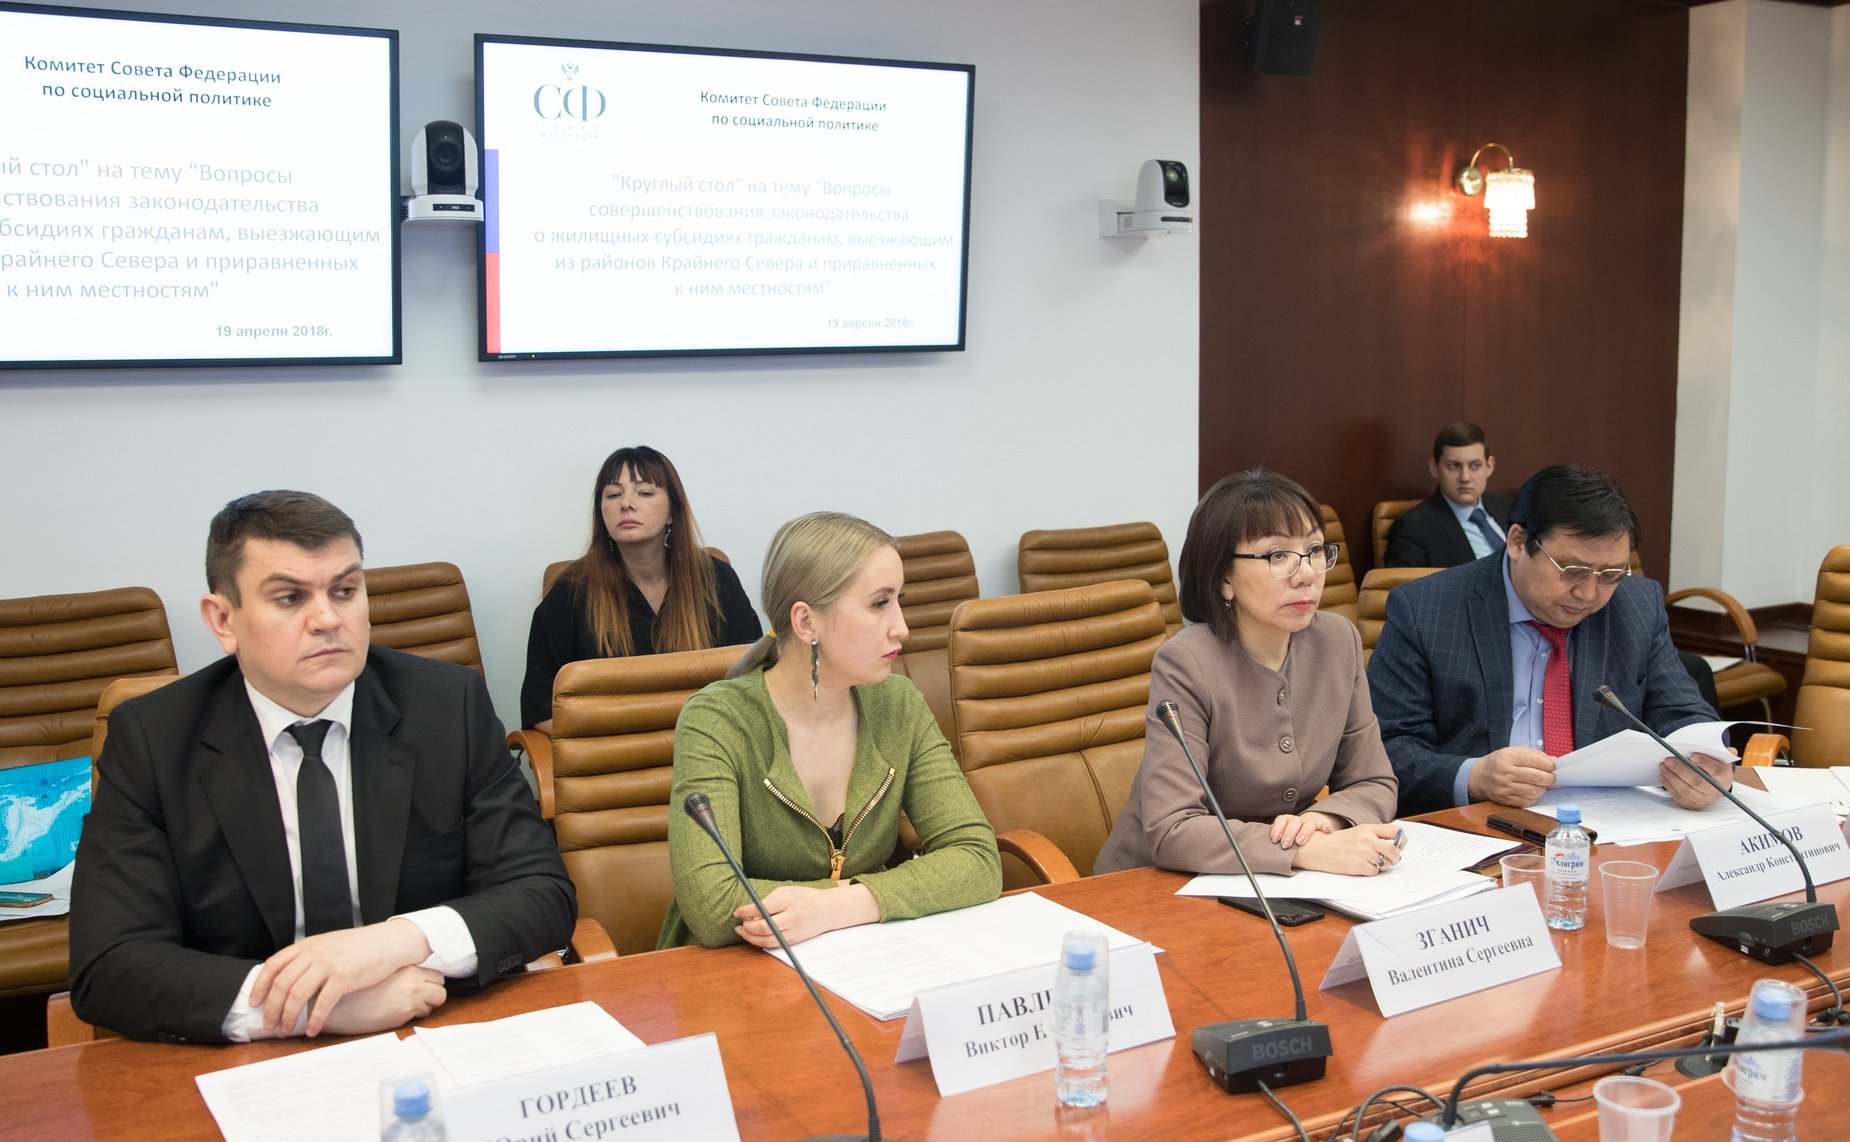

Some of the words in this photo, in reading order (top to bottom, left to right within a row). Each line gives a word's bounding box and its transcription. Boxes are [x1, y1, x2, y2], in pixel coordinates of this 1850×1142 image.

[24, 55, 106, 74] Комитет
[110, 60, 173, 78] Совета
[178, 64, 281, 86] Федерации
[41, 84, 66, 97] по
[70, 86, 183, 103] социальной
[189, 92, 272, 108] политике
[533, 84, 606, 122] СФ
[700, 90, 760, 106] Комитет
[762, 93, 808, 109] Совета
[811, 95, 887, 113] Федерации
[711, 114, 729, 127] по
[731, 115, 817, 129] социальной
[818, 119, 880, 132] политике
[30, 160, 88, 176] стол"
[98, 165, 123, 178] на
[130, 166, 182, 184] тему
[190, 164, 291, 186] "Вопросы
[612, 173, 693, 195] "Круглый
[698, 177, 742, 193] стол"
[748, 183, 768, 192] на
[773, 183, 809, 198] тему
[816, 181, 891, 199] "Вопросы
[129, 197, 318, 213] законодательства
[589, 204, 763, 221] совершенствования
[770, 208, 909, 223] законодательства
[102, 226, 231, 244] гражданам,
[238, 228, 380, 246] выезжающим
[534, 230, 545, 243] о
[550, 231, 649, 246] жилищных
[654, 227, 742, 248] субсидиях
[749, 234, 843, 249] гражданам,
[848, 234, 954, 249] выезжающим
[101, 251, 178, 273] Севера
[186, 256, 198, 269] и
[206, 256, 358, 273] приравненных
[554, 257, 576, 271] из
[580, 253, 656, 273] районов
[661, 254, 741, 273] Крайнего
[745, 255, 803, 273] Севера
[808, 259, 818, 270] и
[823, 259, 937, 273] приравненных
[7, 284, 18, 297] к
[26, 284, 73, 298] ним
[80, 280, 219, 298] местностям"
[675, 284, 684, 296] к
[689, 284, 724, 296] ним
[729, 281, 832, 295] местностям"
[216, 325, 232, 337] 19
[236, 327, 288, 340] апреля
[293, 326, 333, 337] 2018г.
[827, 318, 840, 329] 19
[841, 319, 882, 331] апреля
[1717, 860, 1766, 882] Александр
[1766, 843, 1841, 868] Консттинович
[1416, 915, 1491, 950] ЗГАНИЧ
[1790, 913, 1830, 936] BOSCH
[1387, 955, 1465, 986] Валентина
[1466, 936, 1534, 963] Сергеевна
[964, 1031, 1029, 1058] Виктор
[1252, 1035, 1313, 1060] BOSCH
[520, 1075, 638, 1120] ГОРДЕЕВ
[564, 1101, 681, 1140] Сергеевич
